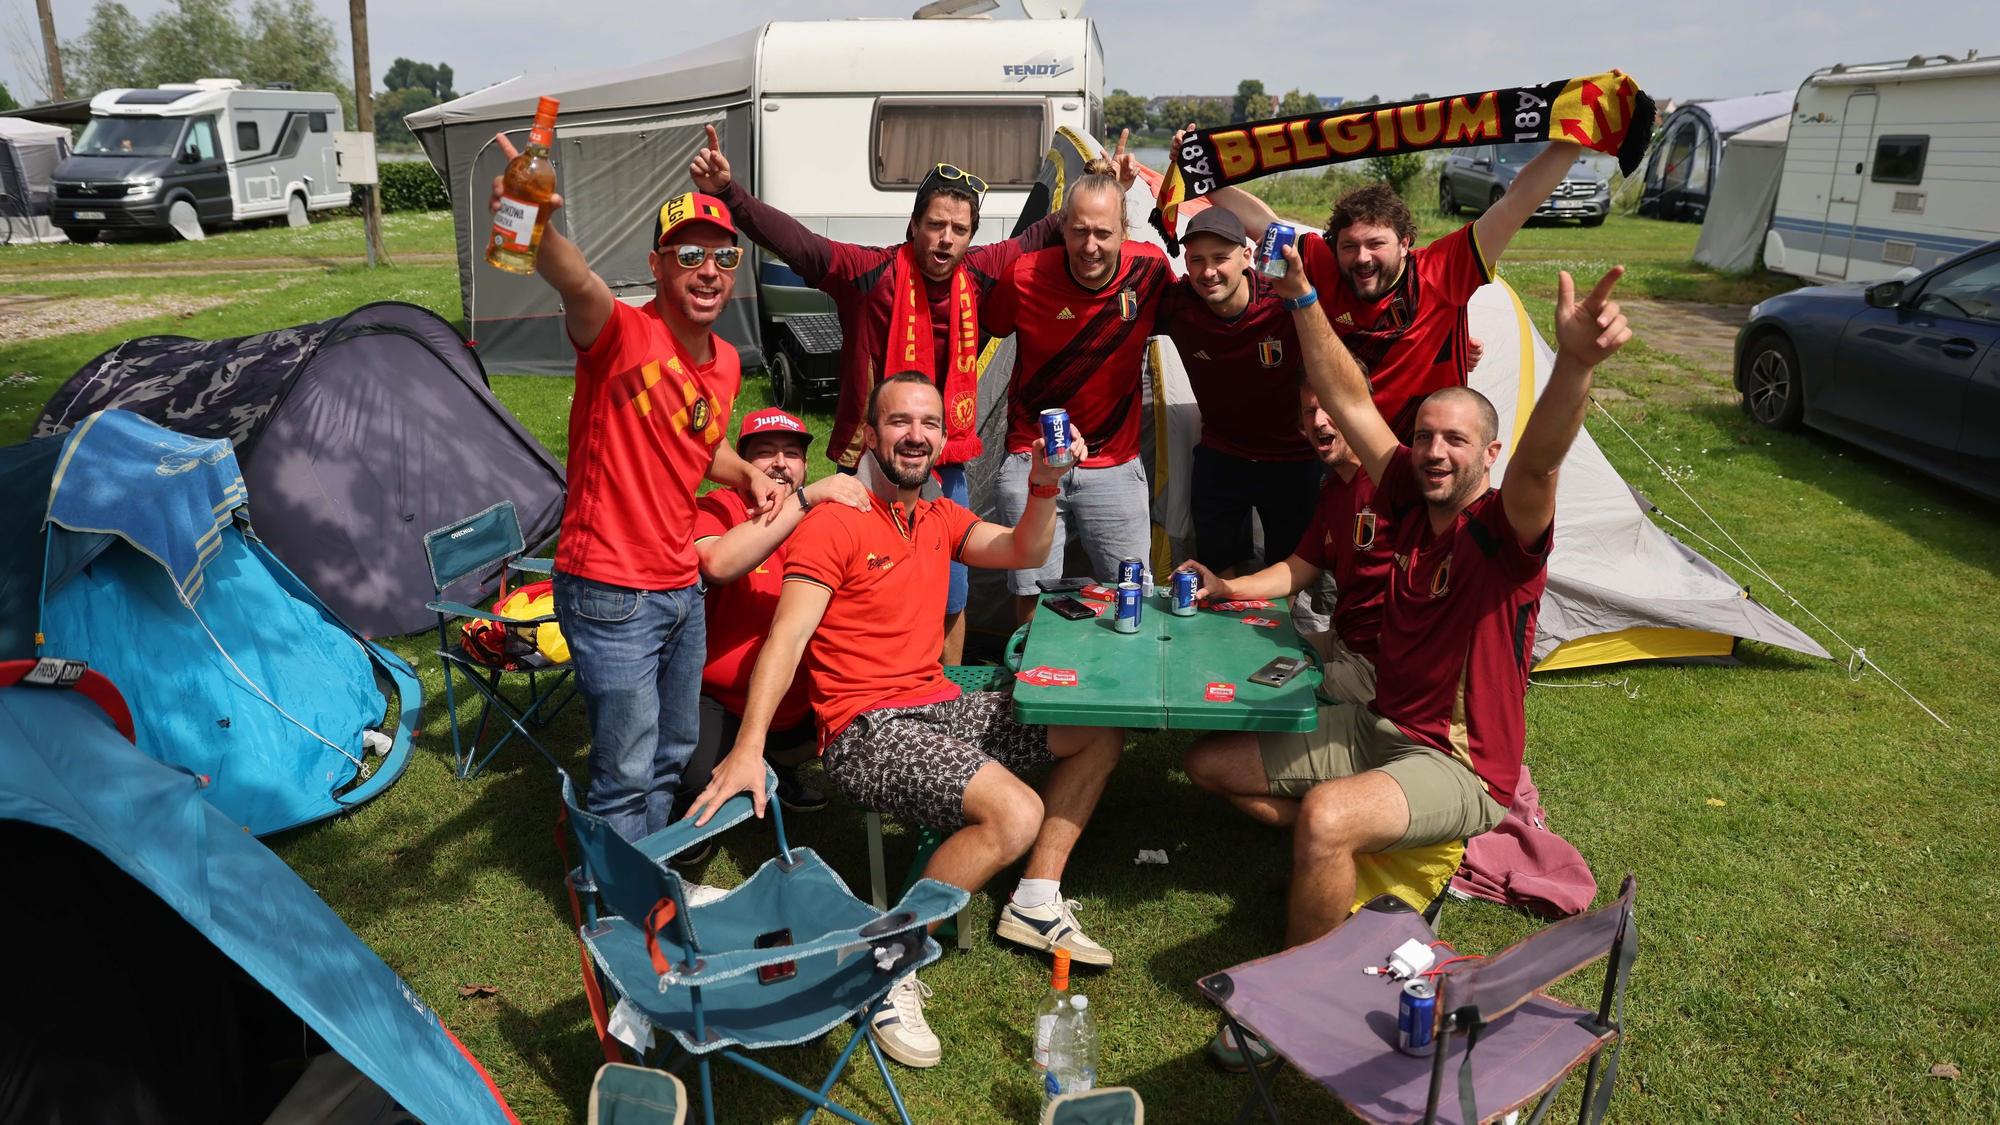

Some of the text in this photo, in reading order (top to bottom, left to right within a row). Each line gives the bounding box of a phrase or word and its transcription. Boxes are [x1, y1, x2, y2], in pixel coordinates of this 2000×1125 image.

[1003, 64, 1060, 76] FENDT
[1513, 81, 1551, 143] 189
[1209, 90, 1501, 179] BELGIUM
[1263, 226, 1278, 257] MAES
[753, 414, 800, 430] Jupiler
[1053, 418, 1065, 448] MAES
[1124, 566, 1133, 583] AES
[1190, 576, 1198, 602] MAES
